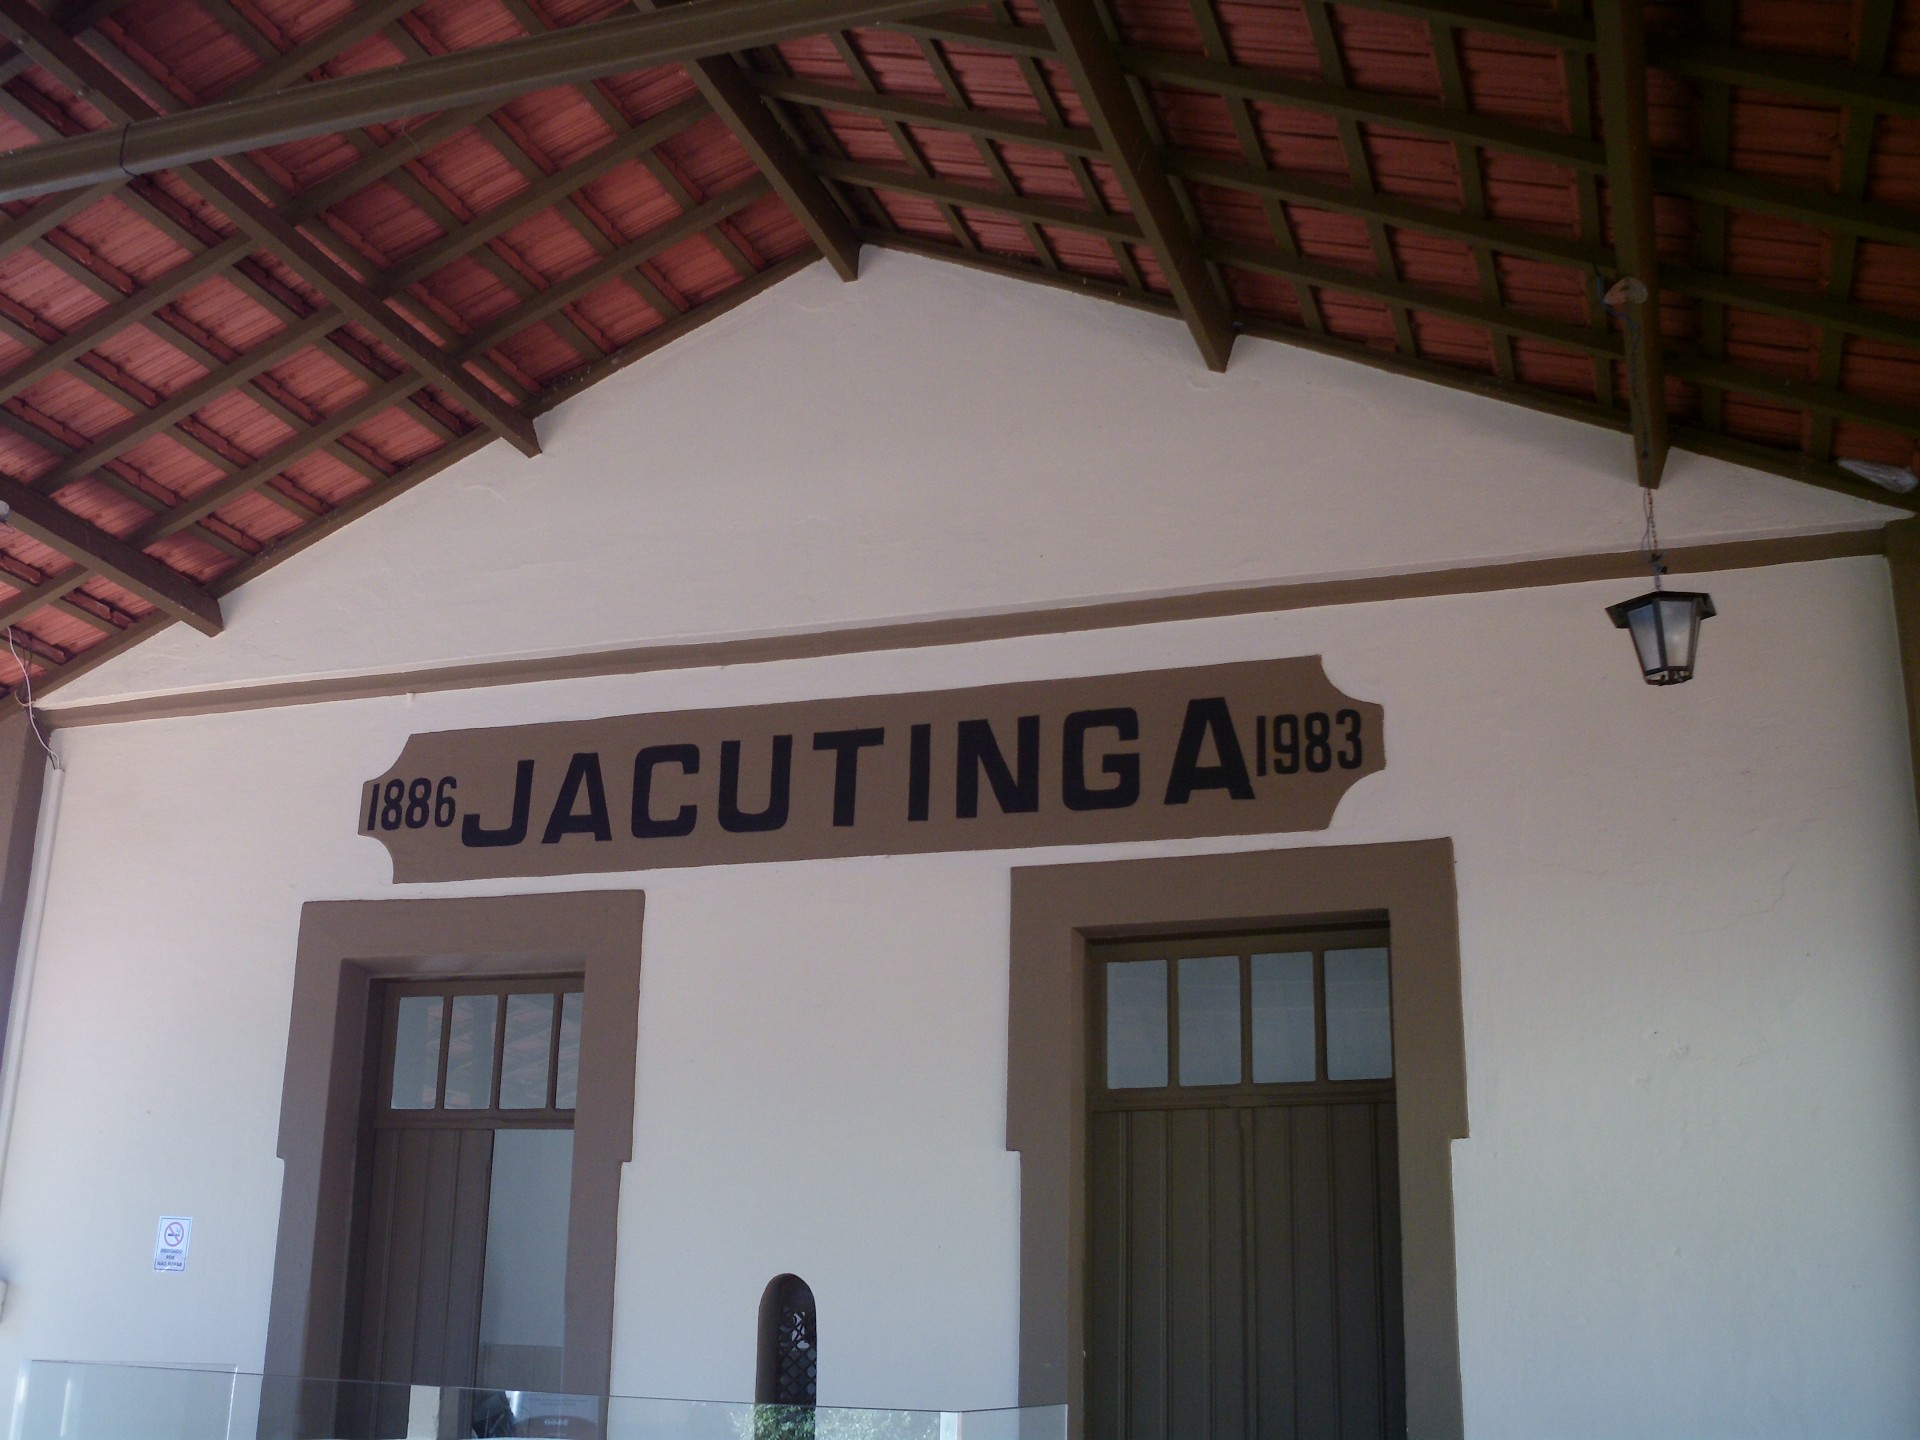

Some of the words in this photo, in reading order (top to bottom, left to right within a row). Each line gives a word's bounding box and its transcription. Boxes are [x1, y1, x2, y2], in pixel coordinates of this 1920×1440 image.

[366, 776, 458, 831] 1886
[461, 696, 1257, 848] JACUTINGA
[1256, 708, 1364, 778] 1983
